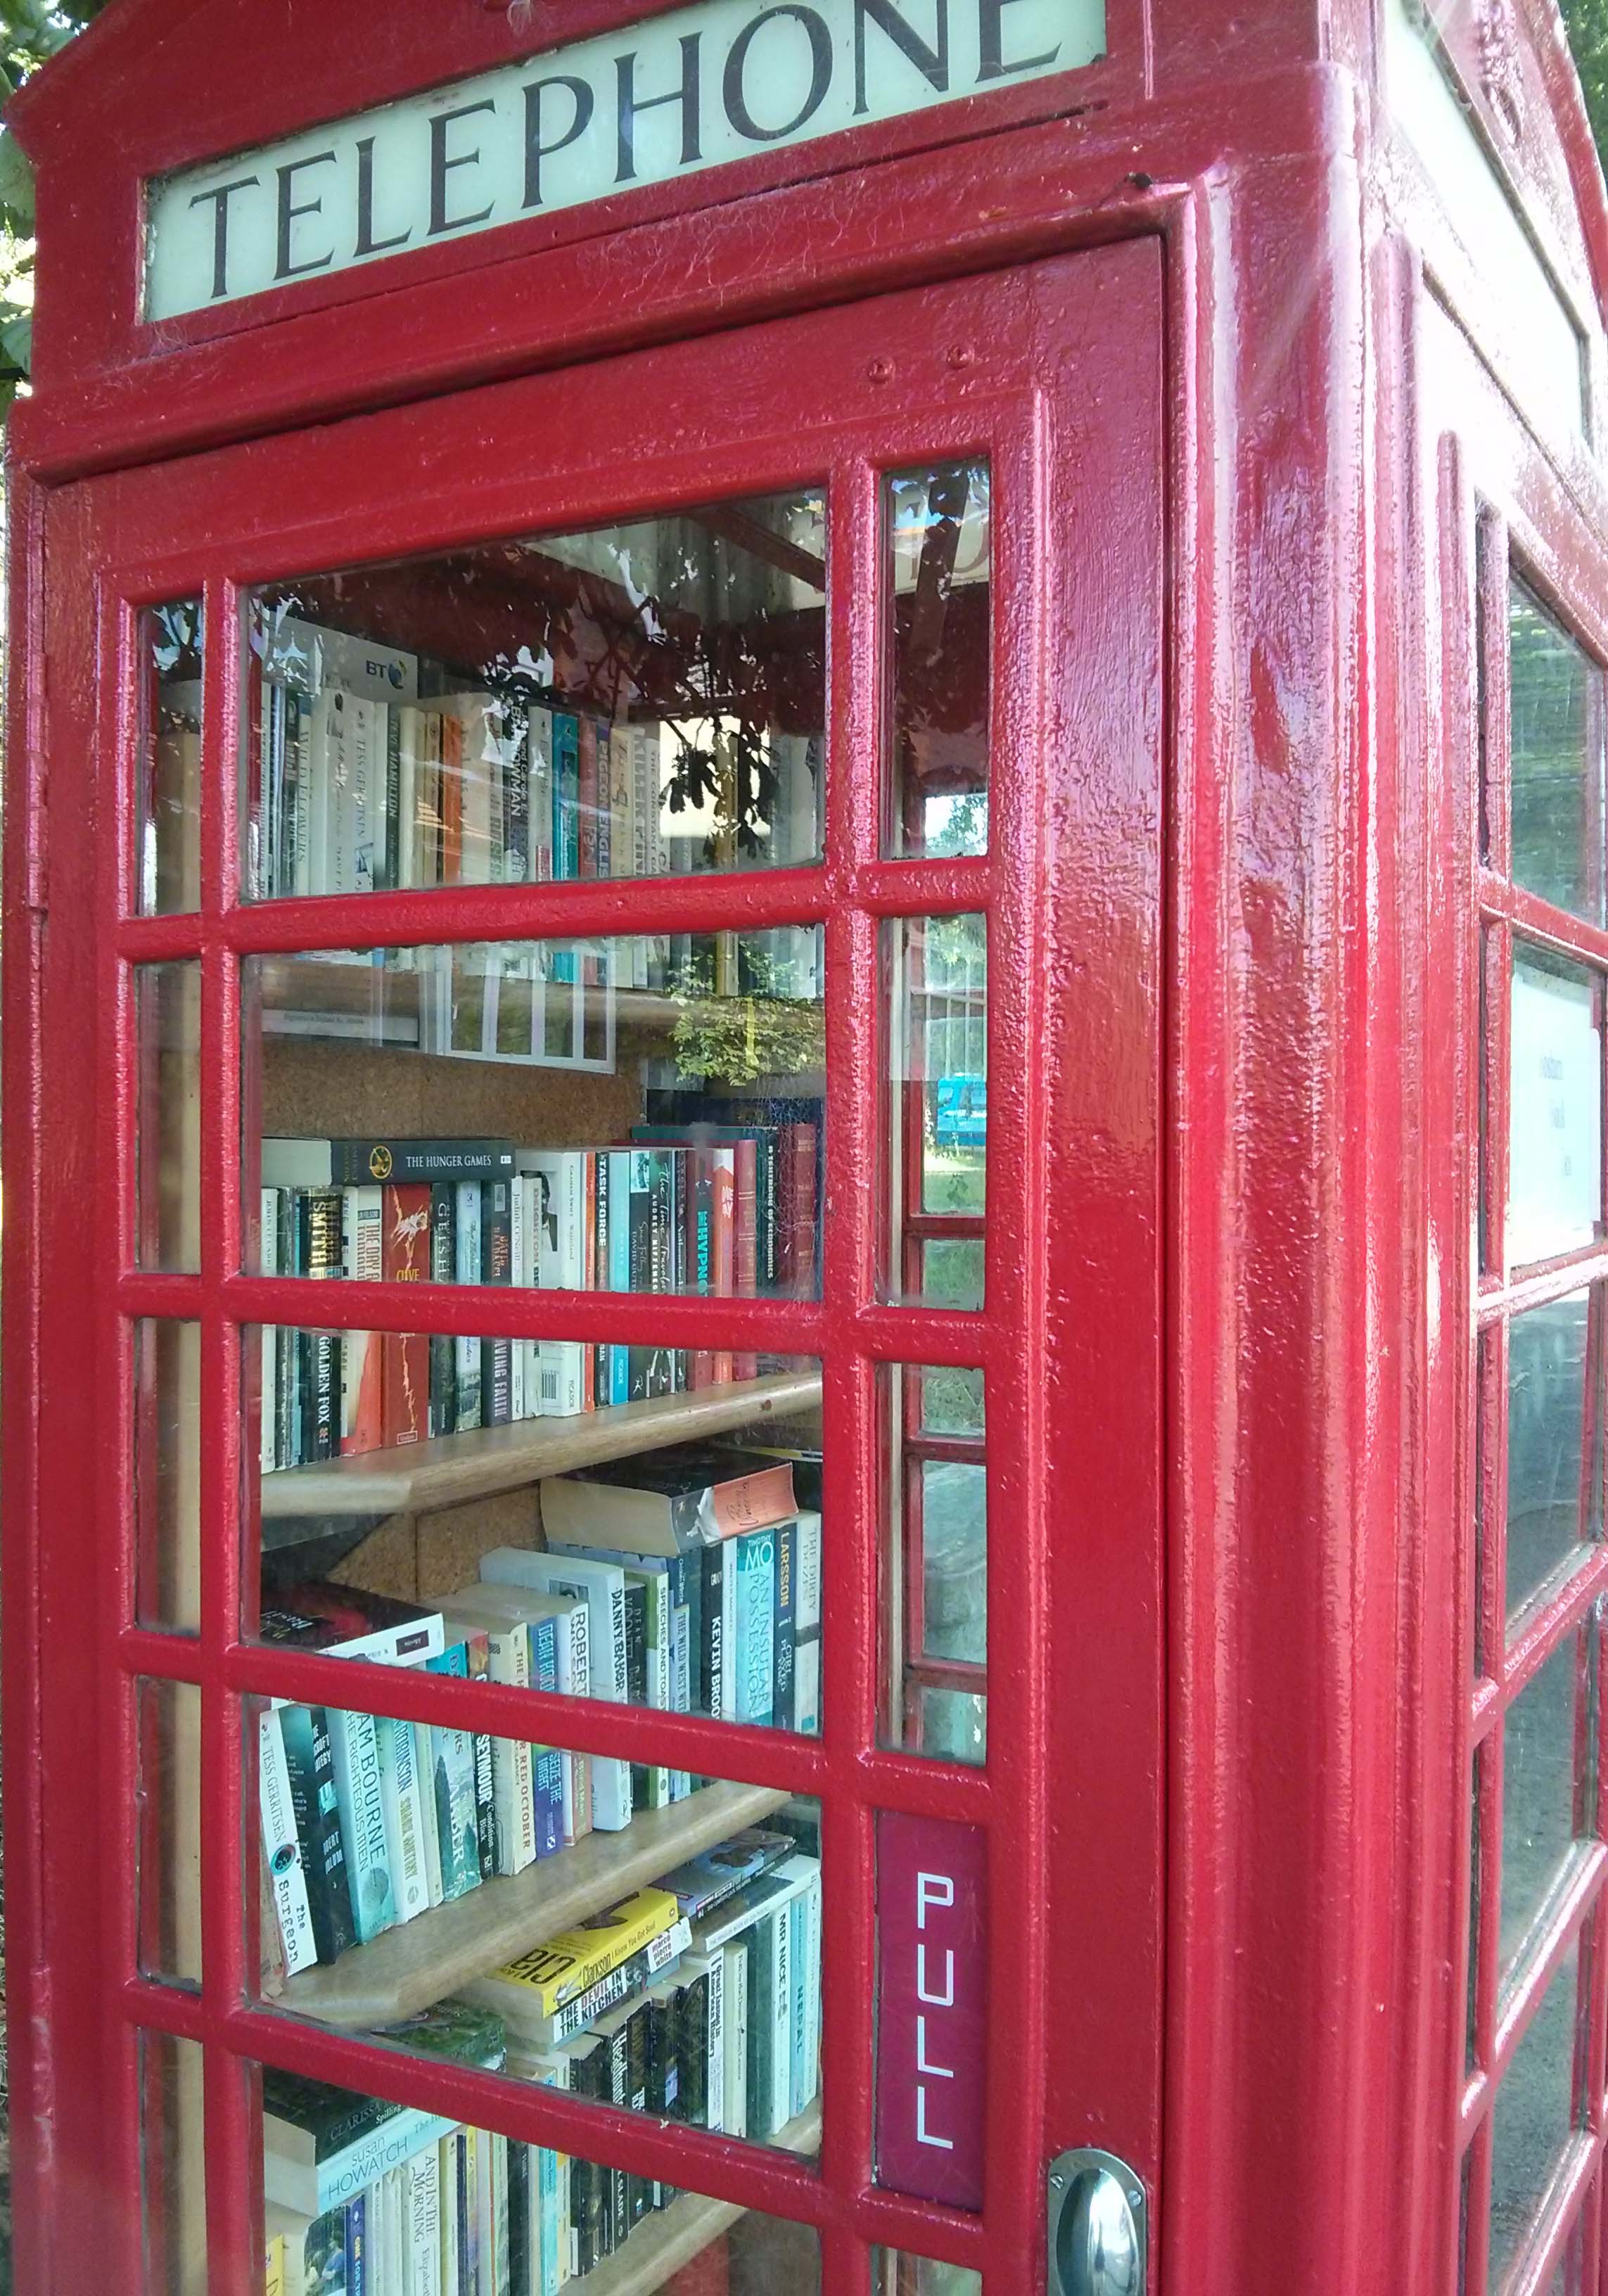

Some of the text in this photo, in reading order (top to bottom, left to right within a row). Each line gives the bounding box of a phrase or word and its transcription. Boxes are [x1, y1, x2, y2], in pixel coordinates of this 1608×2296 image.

[189, 0, 1062, 298] TELEPHONE
[366, 660, 386, 679] BT
[389, 751, 398, 817] HAMILTON
[598, 740, 608, 810] PIGEON
[407, 1154, 492, 1168] THE HUNGER GAMES
[659, 1163, 670, 1199] The
[312, 1201, 327, 1263] SMITH
[366, 1223, 381, 1244] THE
[513, 1194, 521, 1223] Judith
[659, 1194, 669, 1238] Time
[366, 1246, 381, 1270] DAY
[697, 1227, 708, 1296] HYPNO
[317, 1336, 331, 1424] GOLDEN FOX
[494, 1382, 507, 1417] FAITH
[746, 1540, 774, 1570] MO
[747, 1533, 772, 1547] TIMOTHY
[779, 1531, 789, 1607] LARSSON
[808, 1529, 817, 1610] THE DIRTY
[611, 1588, 624, 1640] DANNY
[677, 1613, 687, 1635] THE
[538, 1623, 554, 1660] DEAN
[575, 1612, 587, 1696] ROBERT
[677, 1636, 687, 1662] WILD
[747, 1573, 760, 1714] POSSESSION
[758, 1574, 770, 1707] AN INSULAR
[677, 1665, 687, 1690] WEST
[710, 1615, 721, 1721] KEVIN BROO
[395, 1725, 413, 1795] ROBINSON
[476, 1734, 492, 1806] SEYMOUR
[537, 1756, 549, 1792] NIGHT
[549, 1753, 561, 1781] SEIZE
[262, 1747, 286, 1843] TESS GERRITSEN
[348, 1739, 366, 1833] RIGHTEOUS
[361, 1752, 385, 1863] BOURNE
[520, 1755, 531, 1849] RED OCTOBER
[549, 1782, 561, 1805] THE
[487, 1804, 495, 1848] Condition
[279, 1880, 299, 1965] Surgeon
[295, 1905, 306, 1930] The
[651, 1934, 671, 1951] marco
[582, 1953, 612, 1988] Clarkson
[615, 1943, 627, 1958] Know
[627, 1937, 637, 1948] You
[653, 1943, 672, 1960] pierre
[655, 1951, 672, 1967] white
[778, 1913, 787, 1989] MR NICE
[560, 1969, 623, 2024] THE DEVIL IN
[560, 1983, 624, 2037] THE KITCHEN
[918, 1872, 954, 2150] PULL
[329, 2101, 383, 2141] CLARISSA
[376, 2104, 402, 2125] Spilling
[328, 2119, 429, 2201] HOWATCH The
[352, 2136, 386, 2167] susan
[425, 2155, 437, 2190] AND
[413, 2171, 426, 2244] MORNING
